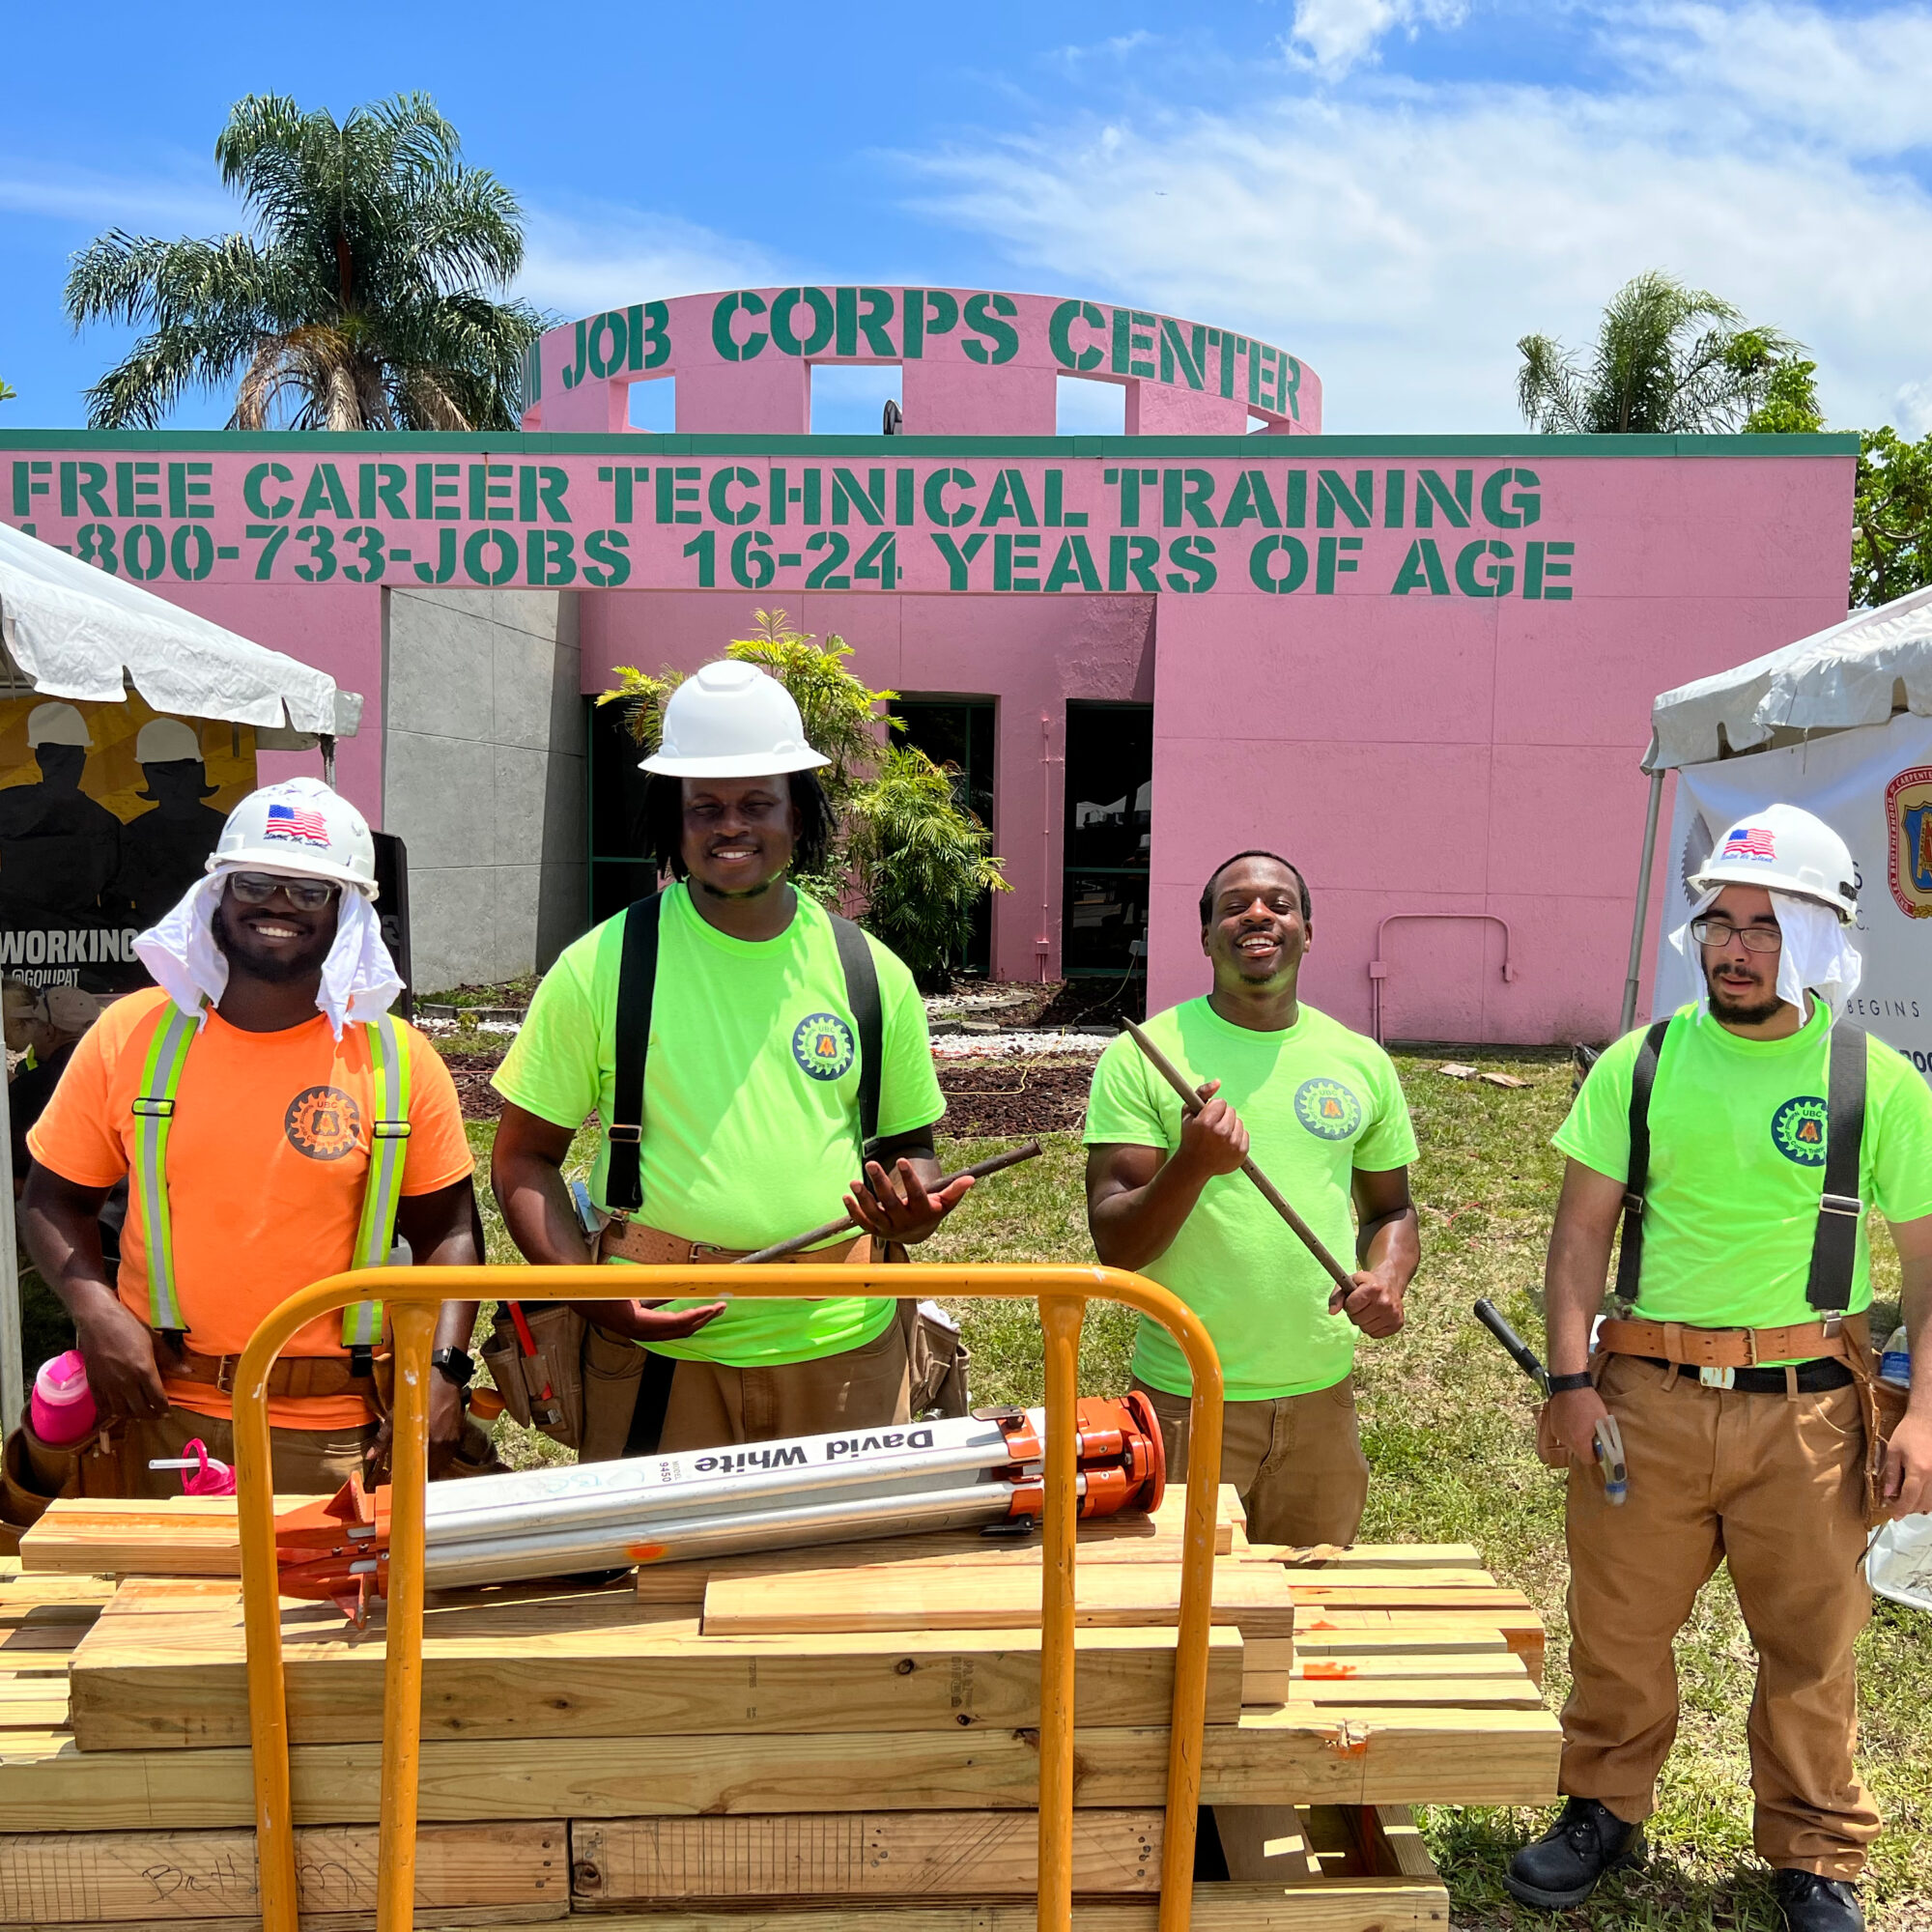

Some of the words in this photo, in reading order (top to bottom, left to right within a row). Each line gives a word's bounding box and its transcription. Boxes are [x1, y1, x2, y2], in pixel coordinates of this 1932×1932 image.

[561, 299, 671, 389] JOB
[713, 287, 1019, 365] CORPS
[1049, 298, 1300, 421] CENTER
[13, 461, 214, 519] FREE
[243, 463, 573, 524] CAREER
[598, 467, 1089, 528] TECHNICAL
[1104, 469, 1542, 529] TRAINING
[20, 524, 631, 586] -800-733-JOBS
[684, 530, 900, 589] 16-24
[931, 533, 1217, 593] YEARS
[1250, 534, 1363, 594] OF
[1392, 540, 1575, 600] AGE
[0, 928, 139, 964] WORKING
[1846, 999, 1919, 1018] BEGINS
[1803, 1109, 1823, 1118] UBC
[694, 1445, 808, 1473] White
[826, 1429, 934, 1461] David
[659, 1462, 671, 1483] 9450
